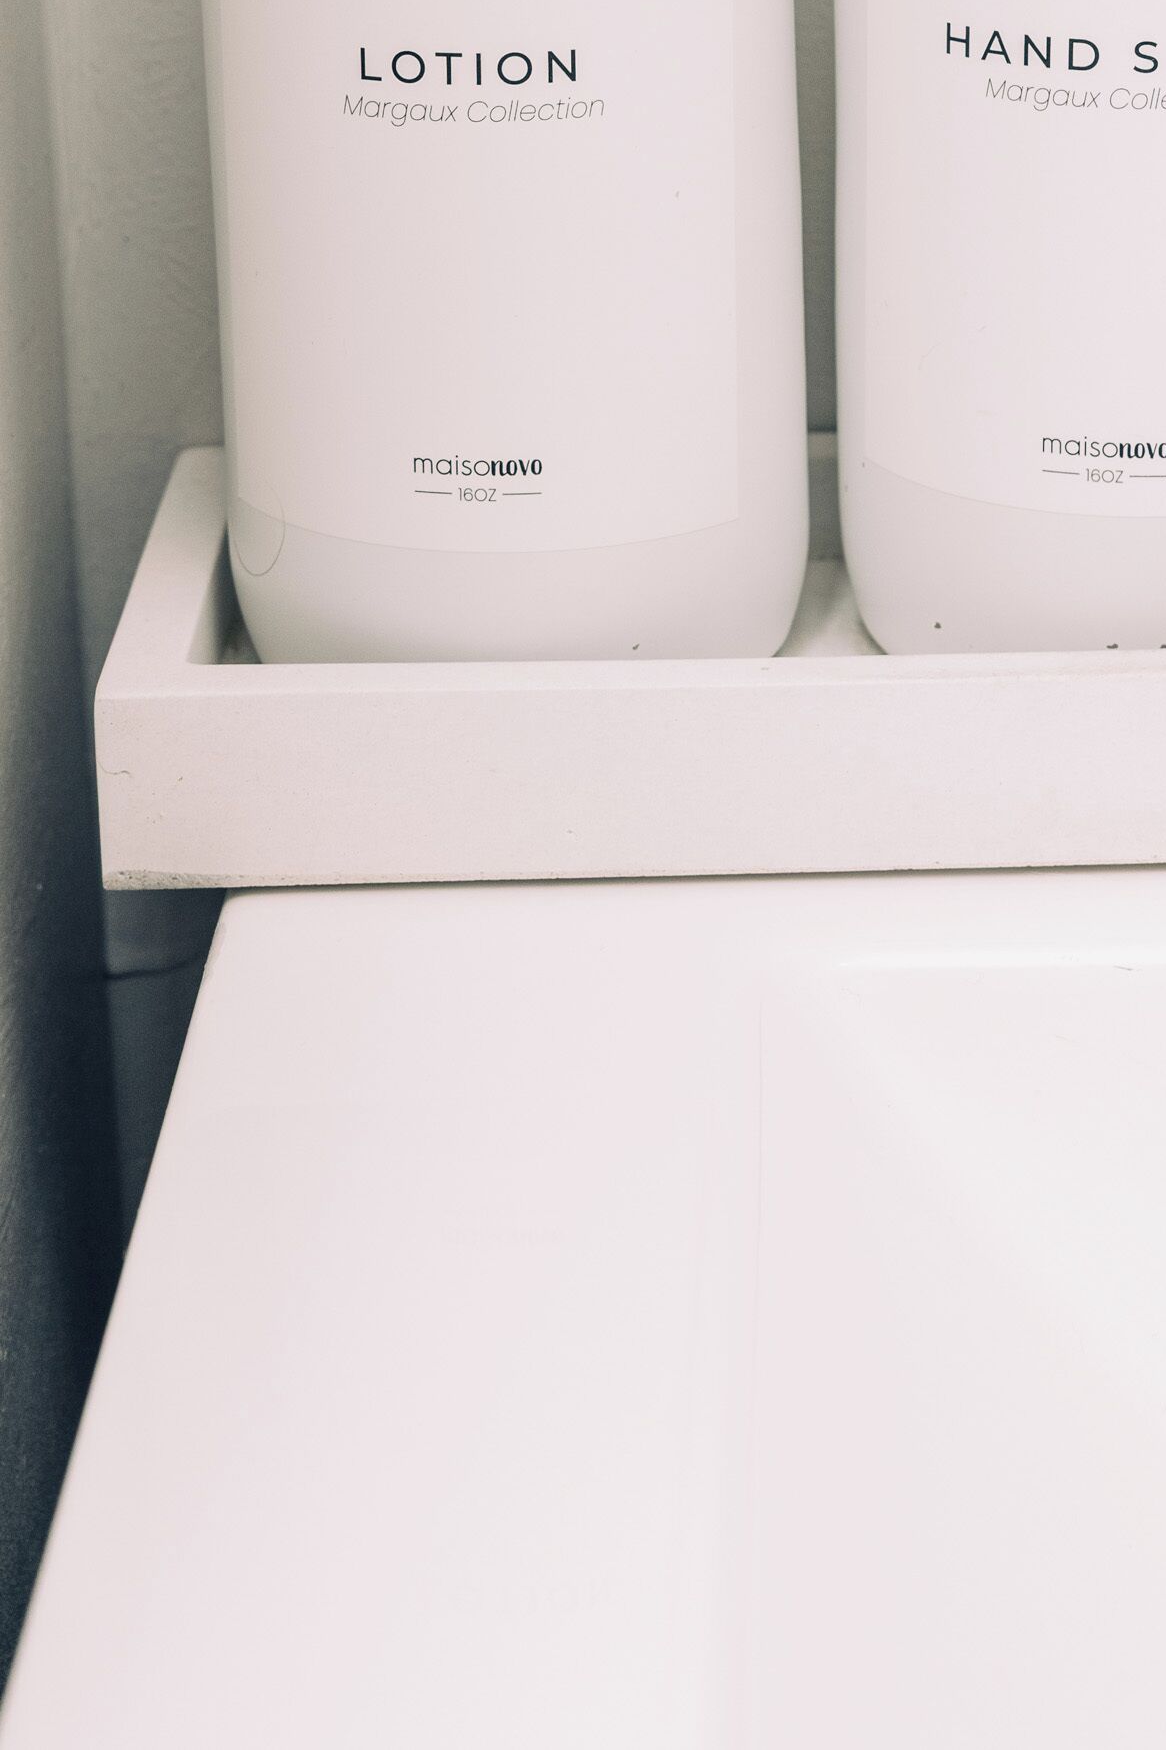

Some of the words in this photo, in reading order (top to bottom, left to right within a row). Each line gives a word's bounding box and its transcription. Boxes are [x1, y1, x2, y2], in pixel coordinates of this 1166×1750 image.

[945, 21, 1101, 72] HAND
[359, 46, 577, 87] LOTION
[342, 93, 459, 128] Margaux
[466, 96, 606, 123] Collection
[985, 77, 1102, 112] Margaux
[413, 454, 543, 478] maisonovo
